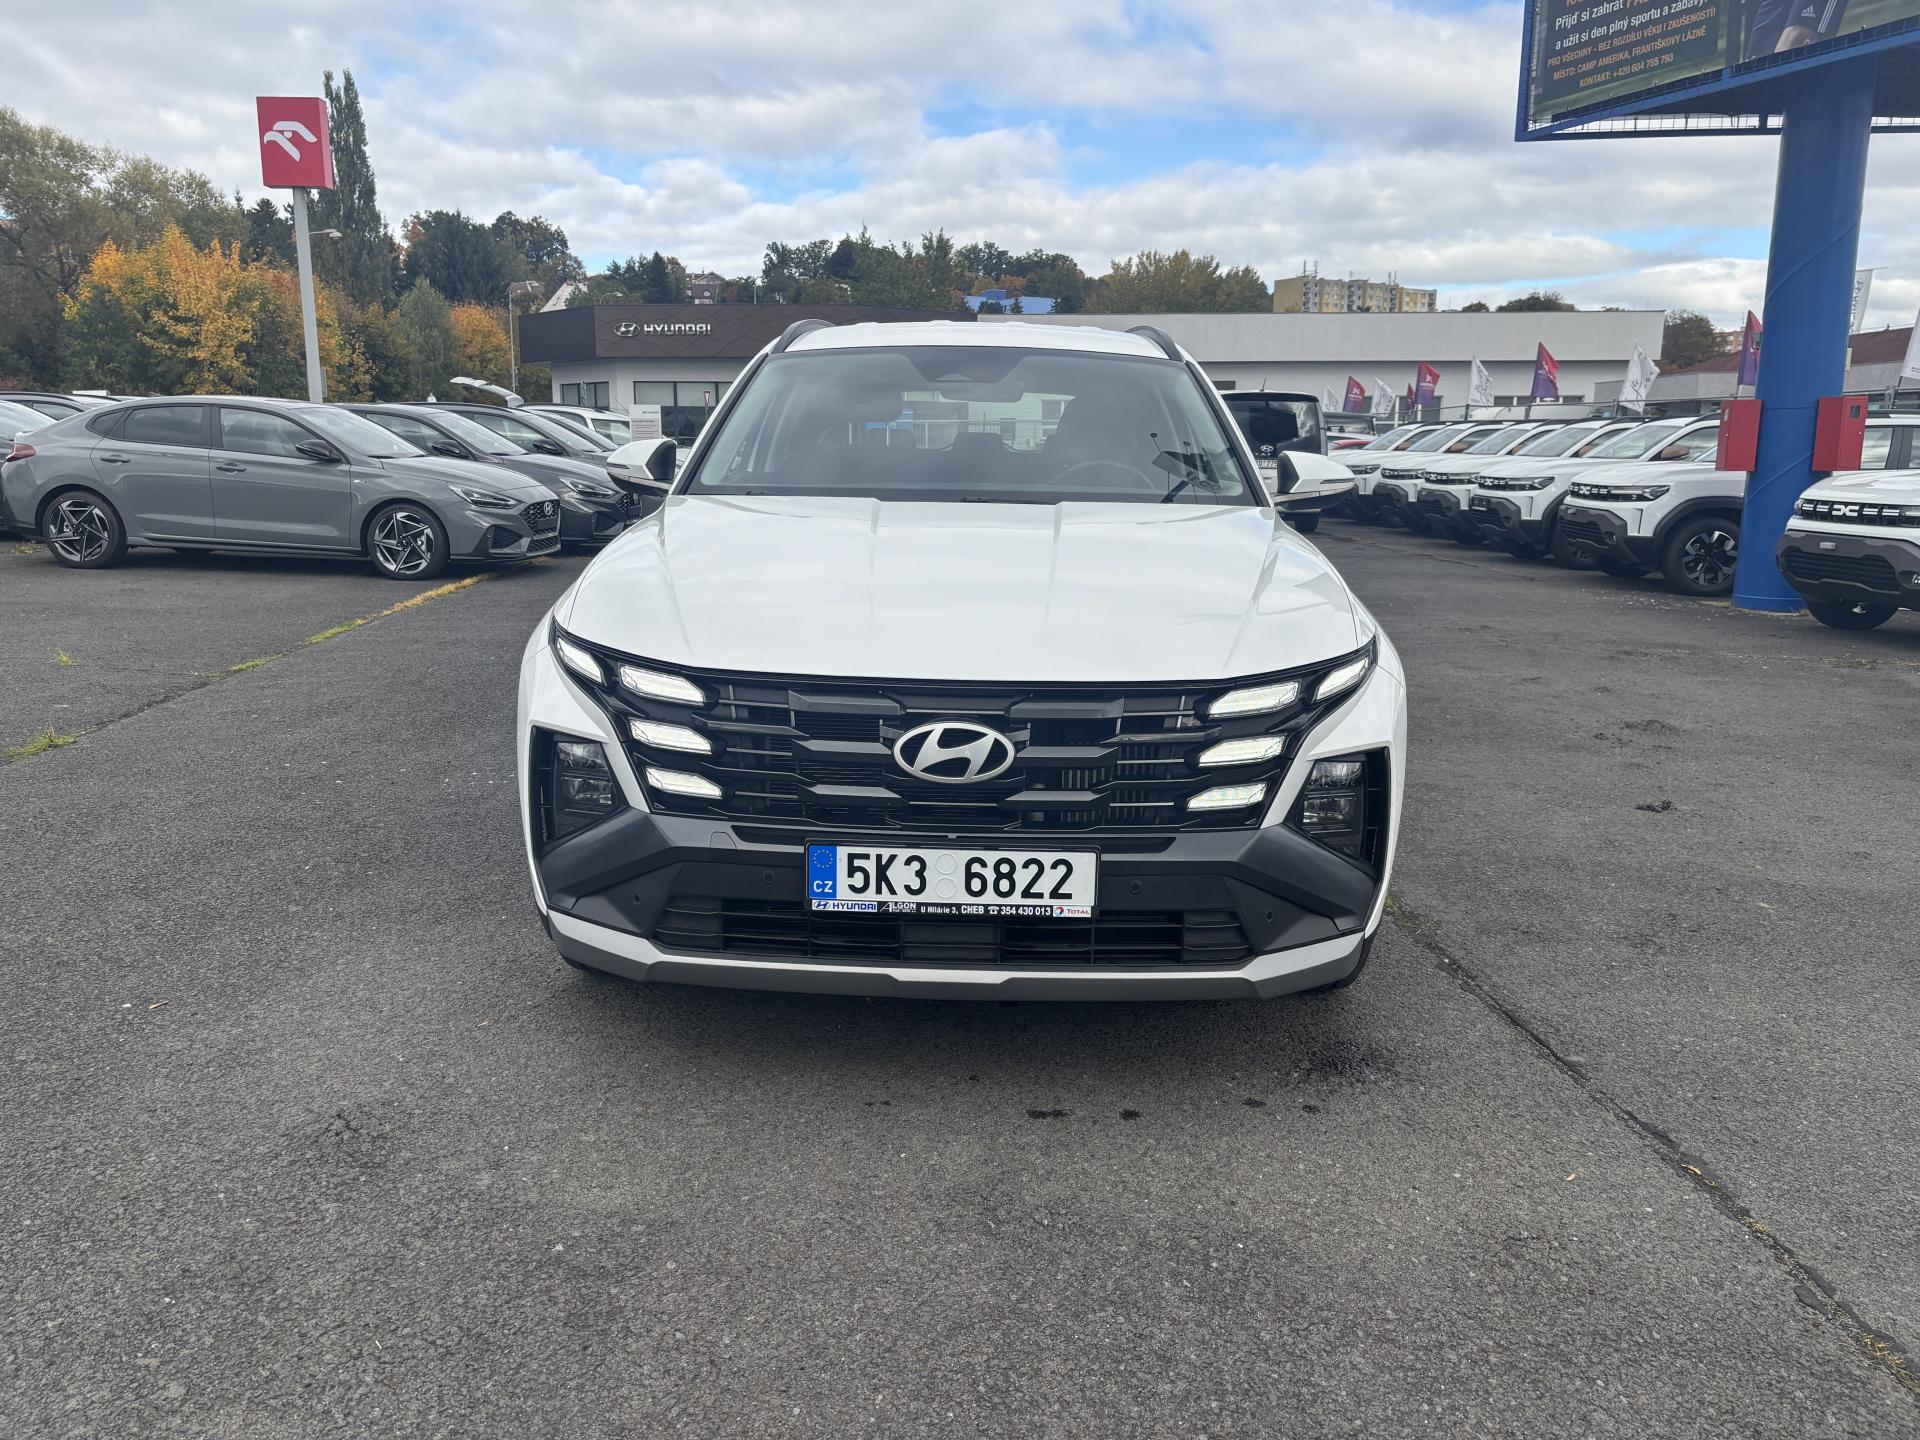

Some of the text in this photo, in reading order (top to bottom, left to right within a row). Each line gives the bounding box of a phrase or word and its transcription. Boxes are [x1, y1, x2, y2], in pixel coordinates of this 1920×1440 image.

[1581, 7, 1590, 22] si
[1555, 40, 1561, 50] a
[1580, 29, 1589, 42] si
[1591, 26, 1607, 39] den
[1609, 16, 1629, 35] plný
[1630, 7, 1660, 27] sportu
[1662, 6, 1669, 16] a
[1562, 46, 1593, 63] VŠECHNY
[1598, 40, 1612, 52] BEZ
[1577, 60, 1597, 73] CAMP
[1598, 50, 1631, 67] AMERIKA,
[1631, 34, 1681, 57] FRANTIŠKOVY
[1682, 24, 1708, 42] LÁZNĚ
[1579, 71, 1612, 88] KONTAKT:
[1613, 65, 1631, 78] +420
[1631, 61, 1645, 73] 604
[1660, 52, 1674, 64] 793
[643, 323, 711, 335] HYUNDAI
[847, 853, 1074, 900] 5K3 6822
[813, 881, 833, 893] CZ
[832, 901, 878, 911] HYUNDAI
[879, 901, 917, 912] ALGON
[920, 905, 926, 913] U
[951, 906, 959, 915] 3,
[961, 905, 985, 914] CHEB
[1000, 906, 1017, 915] 354
[1017, 907, 1034, 916] 430
[1035, 907, 1051, 916] 013
